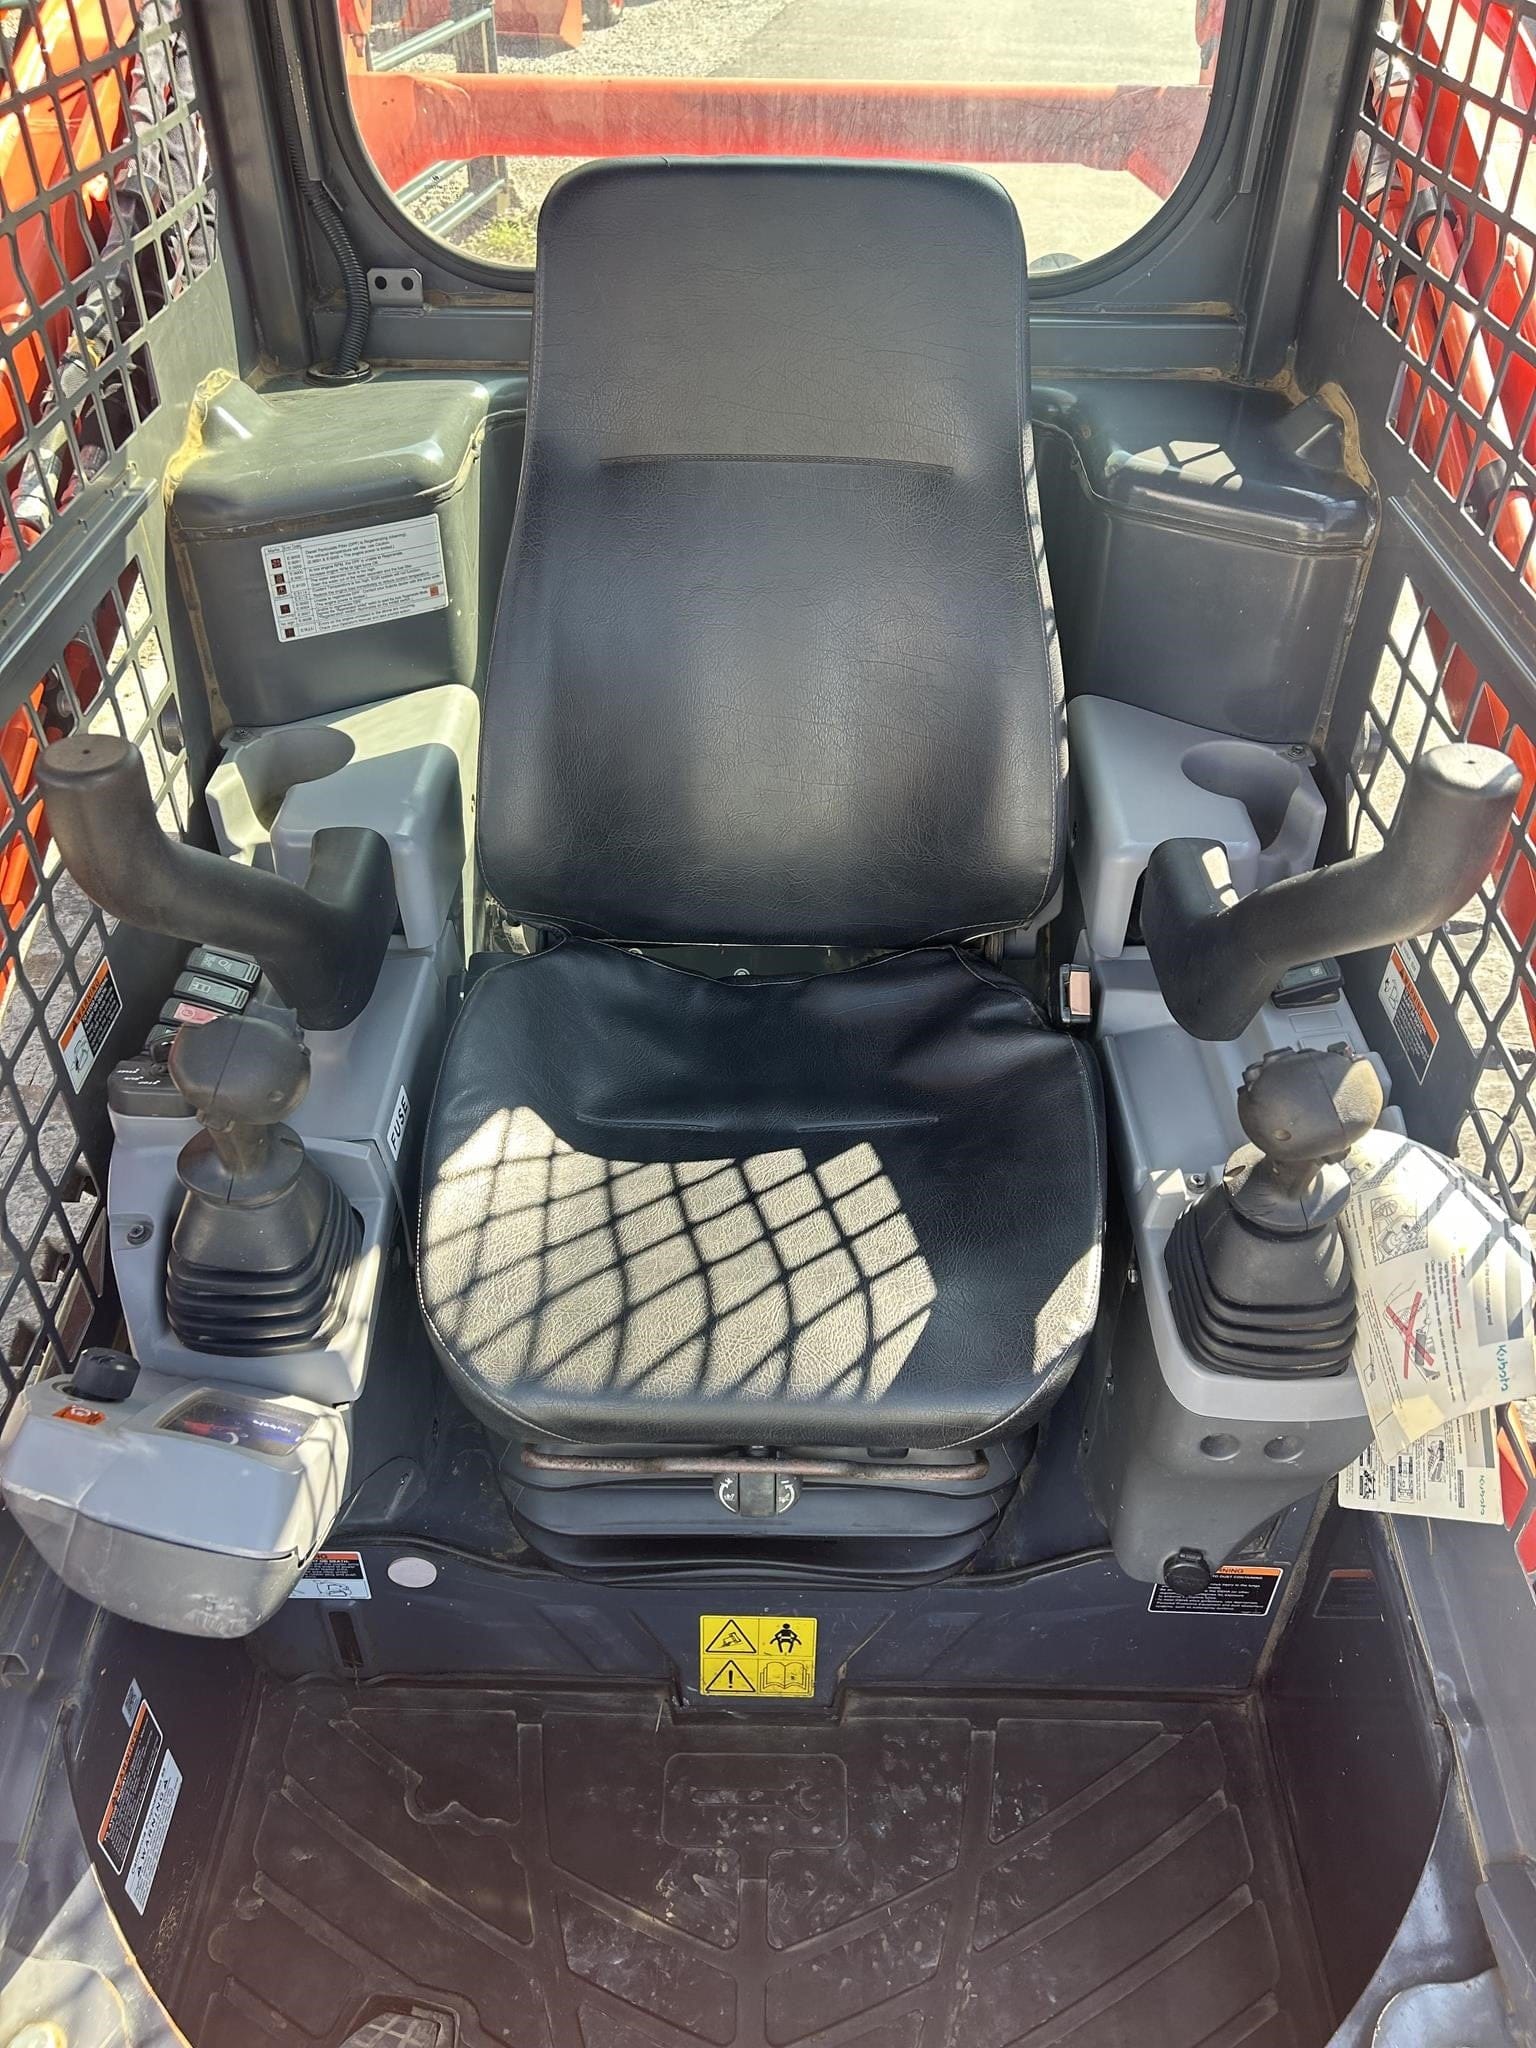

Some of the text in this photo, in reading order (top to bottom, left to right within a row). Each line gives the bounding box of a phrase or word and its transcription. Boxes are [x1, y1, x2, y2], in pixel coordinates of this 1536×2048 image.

[390, 1095, 408, 1151] FUSE
[1495, 1344, 1510, 1392] Kubota
[1479, 1474, 1487, 1516] Kubota
[115, 1728, 138, 1794] WARNING
[139, 1789, 166, 1863] WARNING
